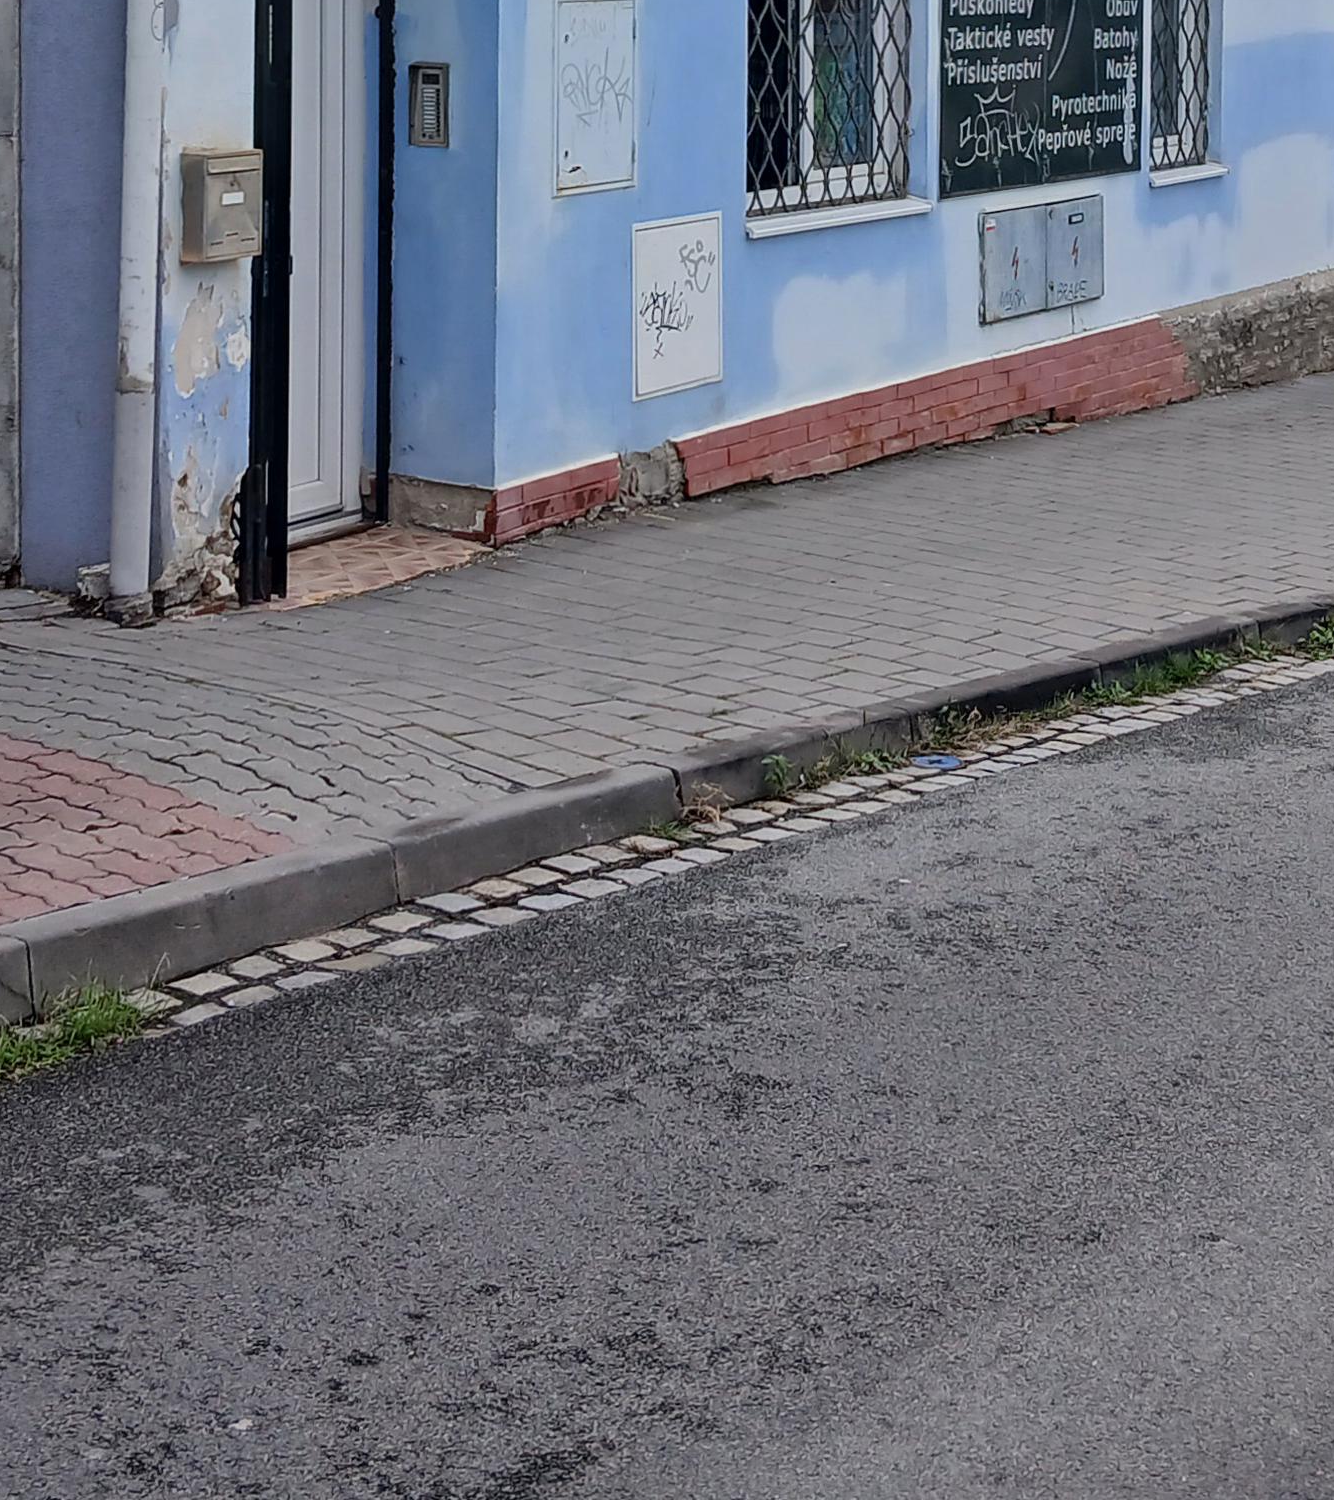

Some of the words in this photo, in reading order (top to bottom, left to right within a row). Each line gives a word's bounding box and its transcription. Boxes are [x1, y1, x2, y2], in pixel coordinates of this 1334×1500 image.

[948, 23, 1012, 51] Taktické
[1017, 24, 1055, 51] vesty
[1094, 26, 1138, 52] Batohy
[948, 54, 1043, 86] Příslušenství
[1052, 88, 1137, 121] Pyrotechnika
[1038, 121, 1091, 154] Pepřové
[1096, 122, 1137, 148] spreje
